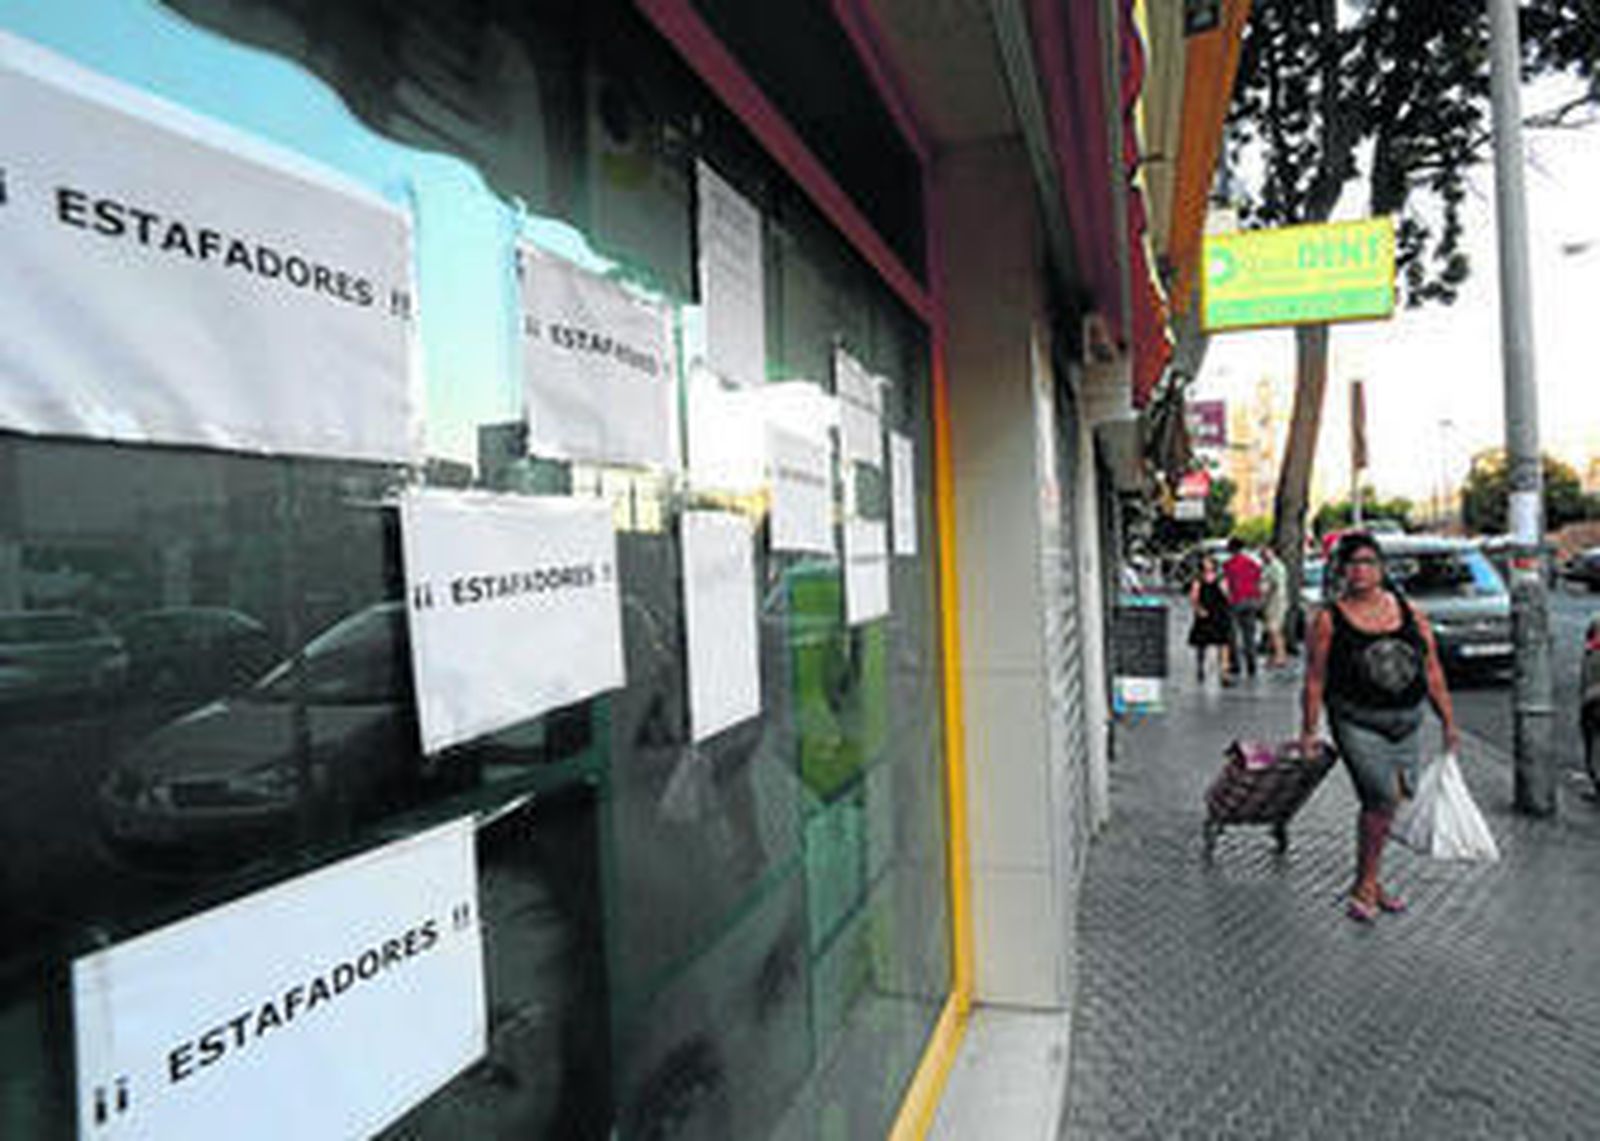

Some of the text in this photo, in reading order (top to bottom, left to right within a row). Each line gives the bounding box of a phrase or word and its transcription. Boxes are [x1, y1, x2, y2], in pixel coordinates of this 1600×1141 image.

[55, 187, 375, 307] ESTAFADORES
[451, 563, 596, 606] ESTAFADORES
[94, 1076, 129, 1125] ¡¡
[167, 919, 439, 1083] ESTAFADORES
